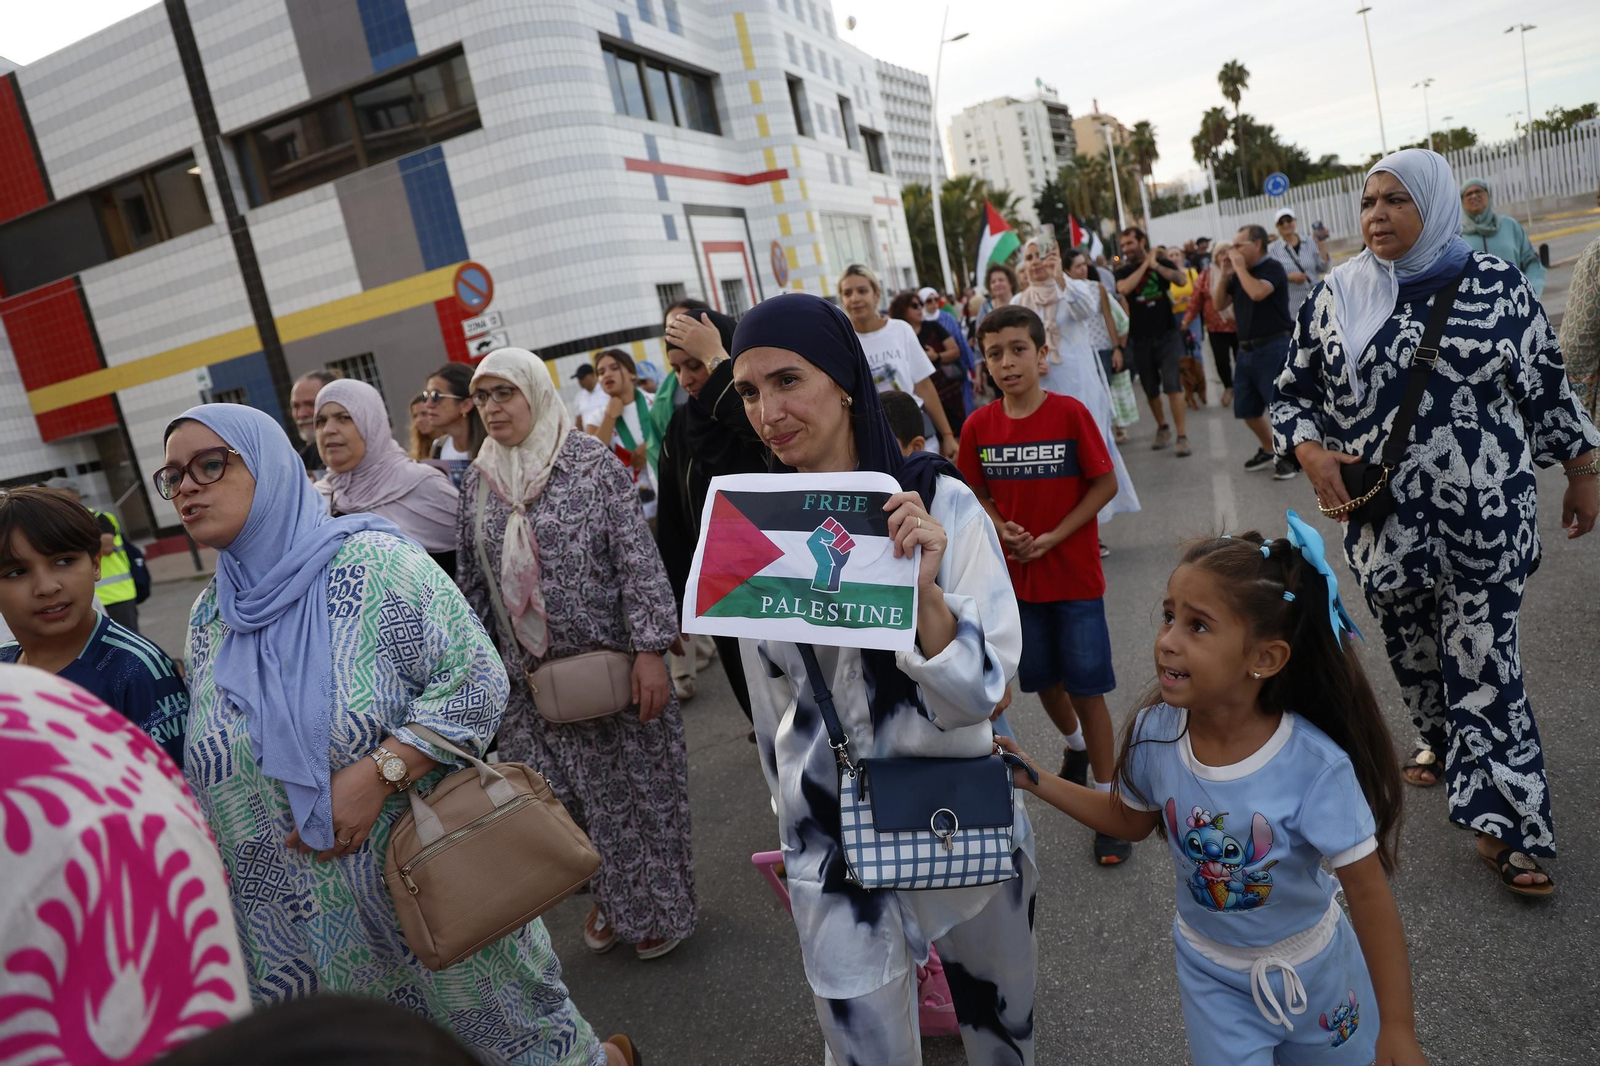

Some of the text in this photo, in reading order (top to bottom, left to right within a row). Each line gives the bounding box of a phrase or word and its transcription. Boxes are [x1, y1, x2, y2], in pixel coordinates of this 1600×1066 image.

[868, 350, 901, 364] ALINA
[803, 494, 868, 513] FREE
[760, 596, 903, 626] PALESTINE
[156, 692, 189, 717] VIS
